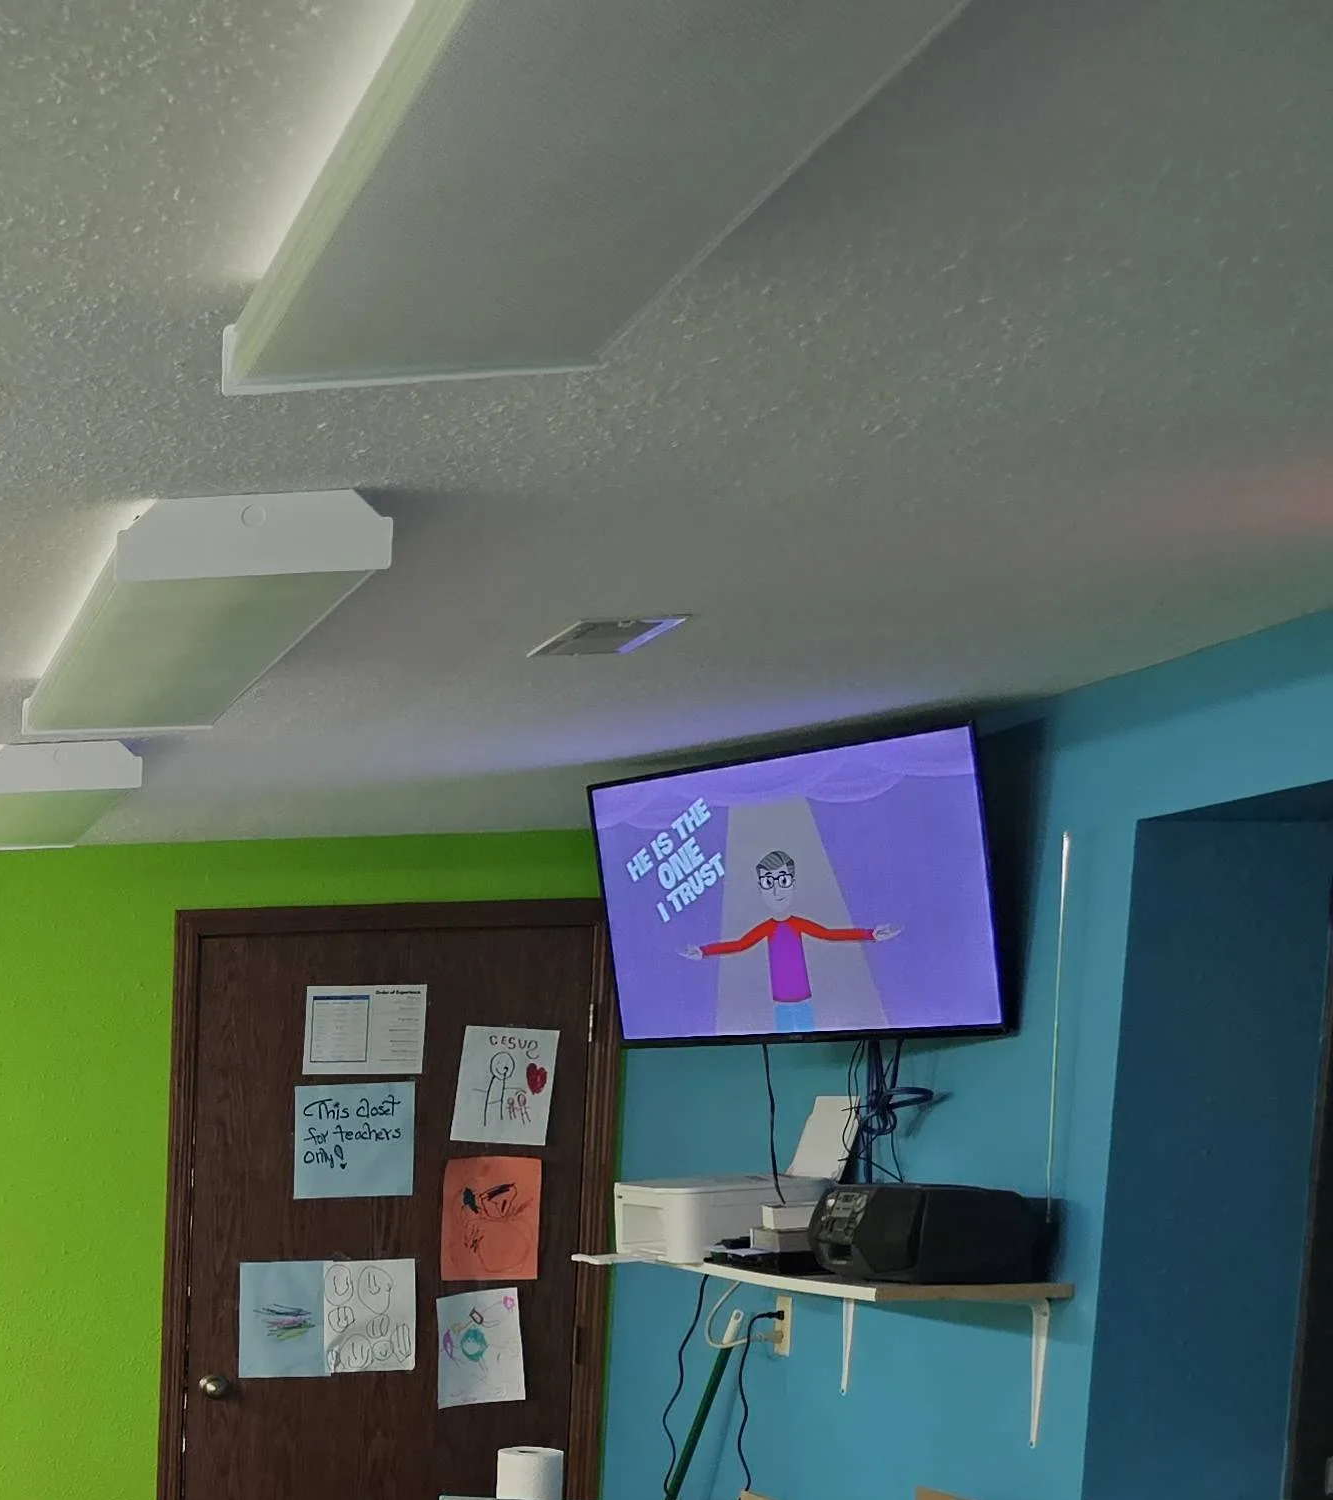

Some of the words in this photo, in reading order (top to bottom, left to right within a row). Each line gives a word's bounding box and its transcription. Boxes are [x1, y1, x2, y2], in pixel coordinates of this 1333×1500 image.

[626, 848, 654, 882] HE
[650, 831, 674, 860] IS
[671, 797, 711, 840] THE
[658, 836, 705, 890] ONE
[656, 902, 671, 923] I
[666, 852, 725, 912] TRUST
[303, 1098, 350, 1120] This
[303, 1127, 329, 1145] for
[333, 1122, 402, 1142] teachers
